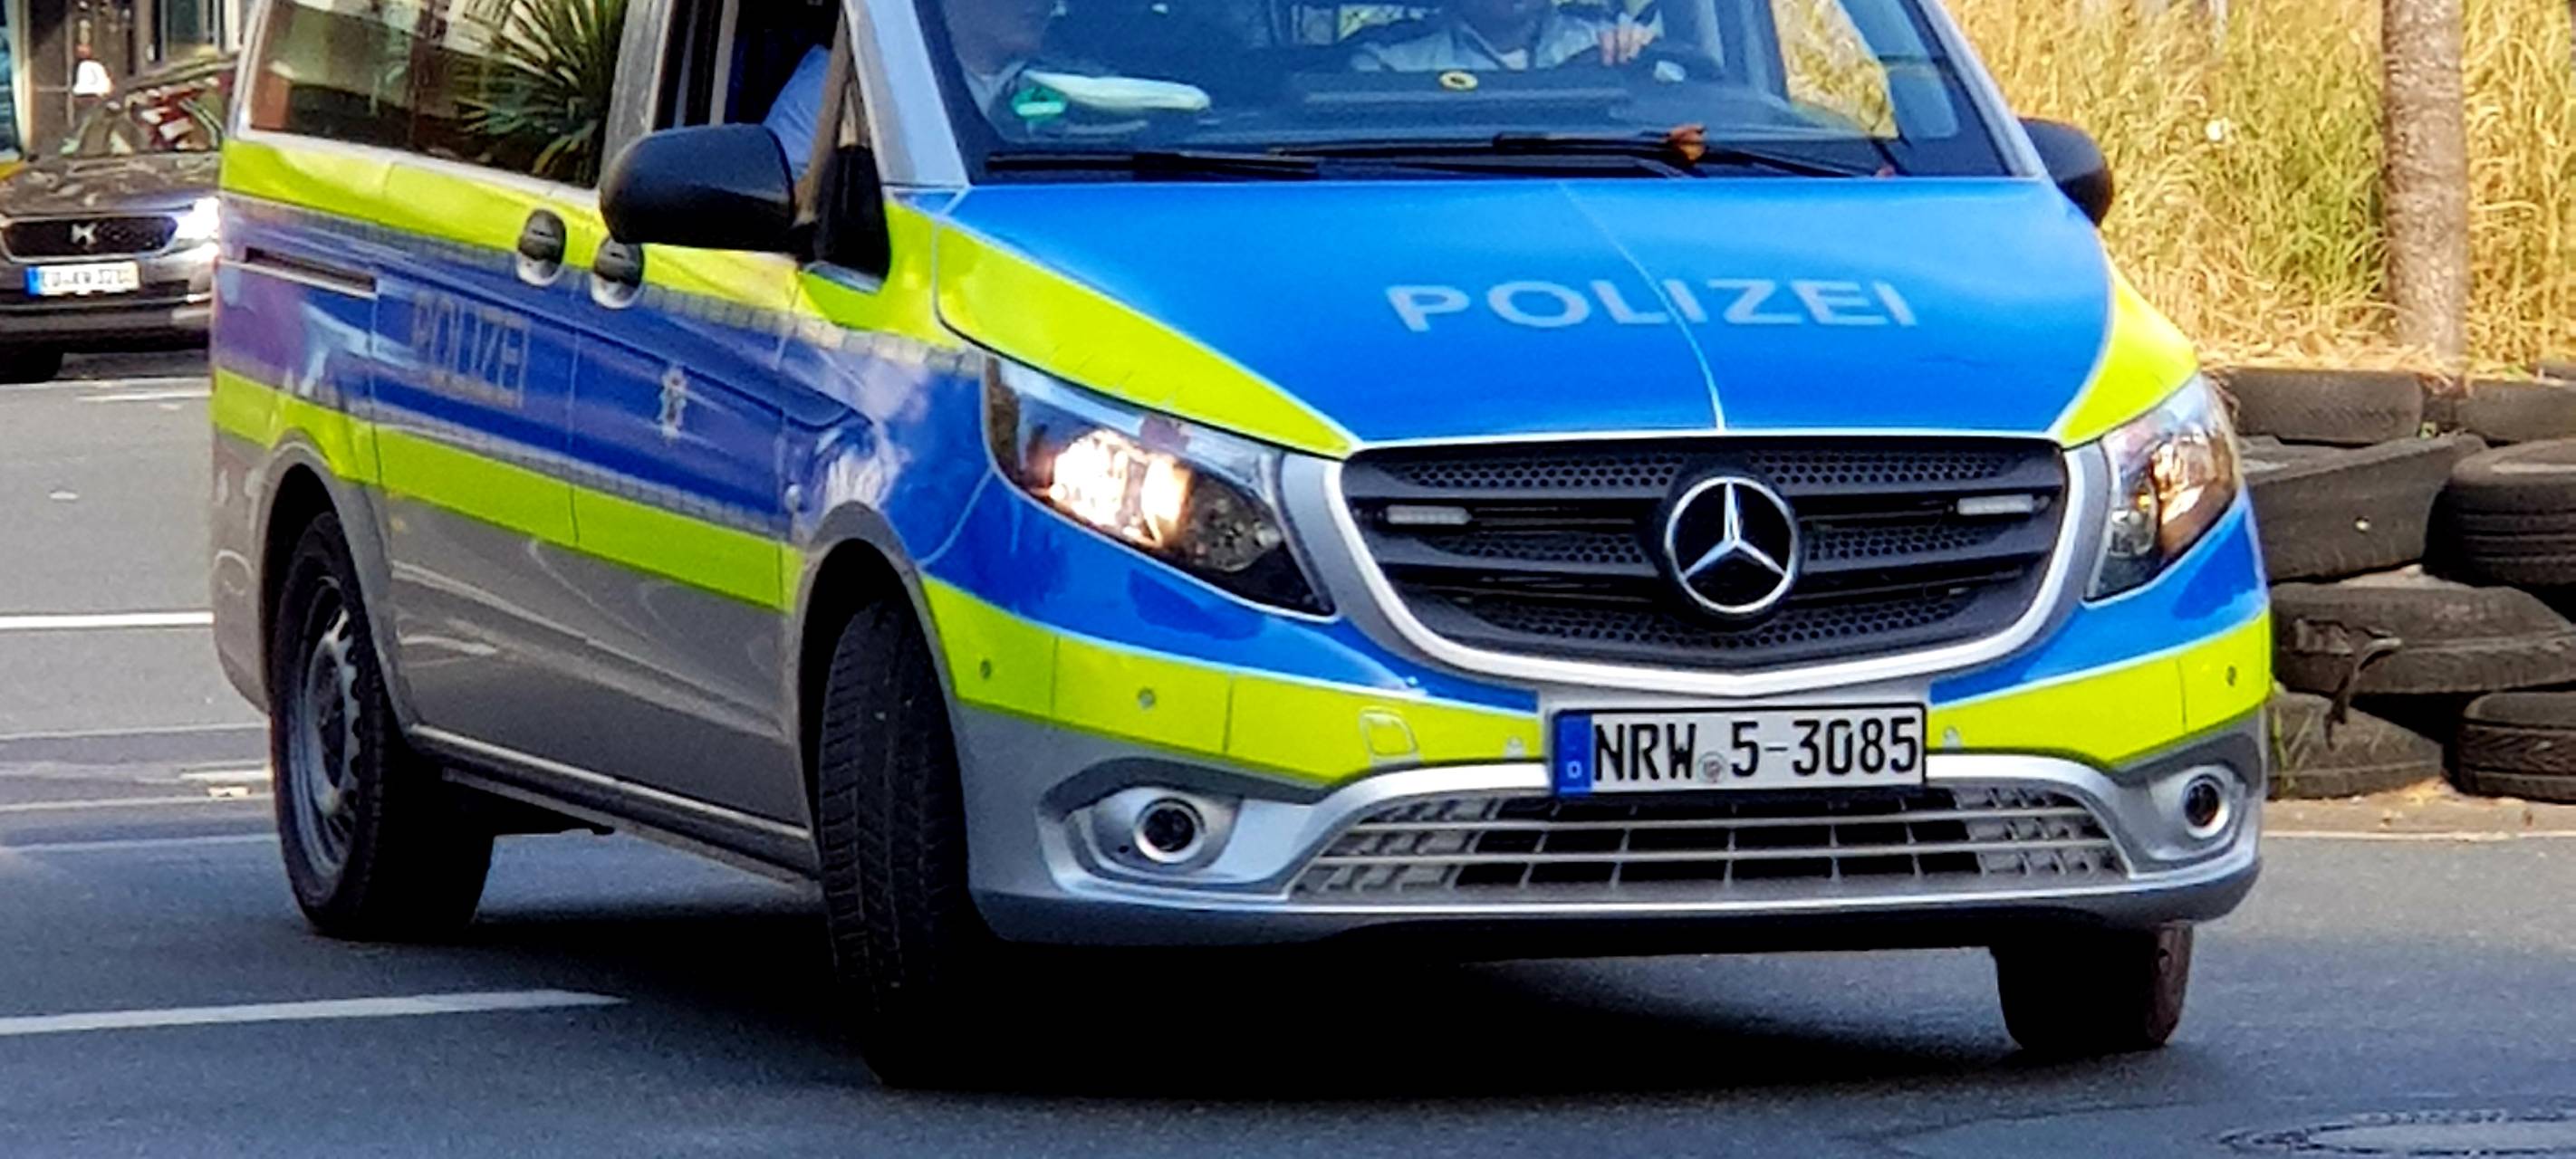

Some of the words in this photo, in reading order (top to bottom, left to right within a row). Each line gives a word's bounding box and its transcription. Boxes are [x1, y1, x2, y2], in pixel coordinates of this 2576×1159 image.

[1384, 279, 1918, 332] POLIZEI
[412, 290, 530, 409] POLIZEI
[1594, 723, 1697, 781] NRW
[1730, 716, 1918, 778] 5-3085
